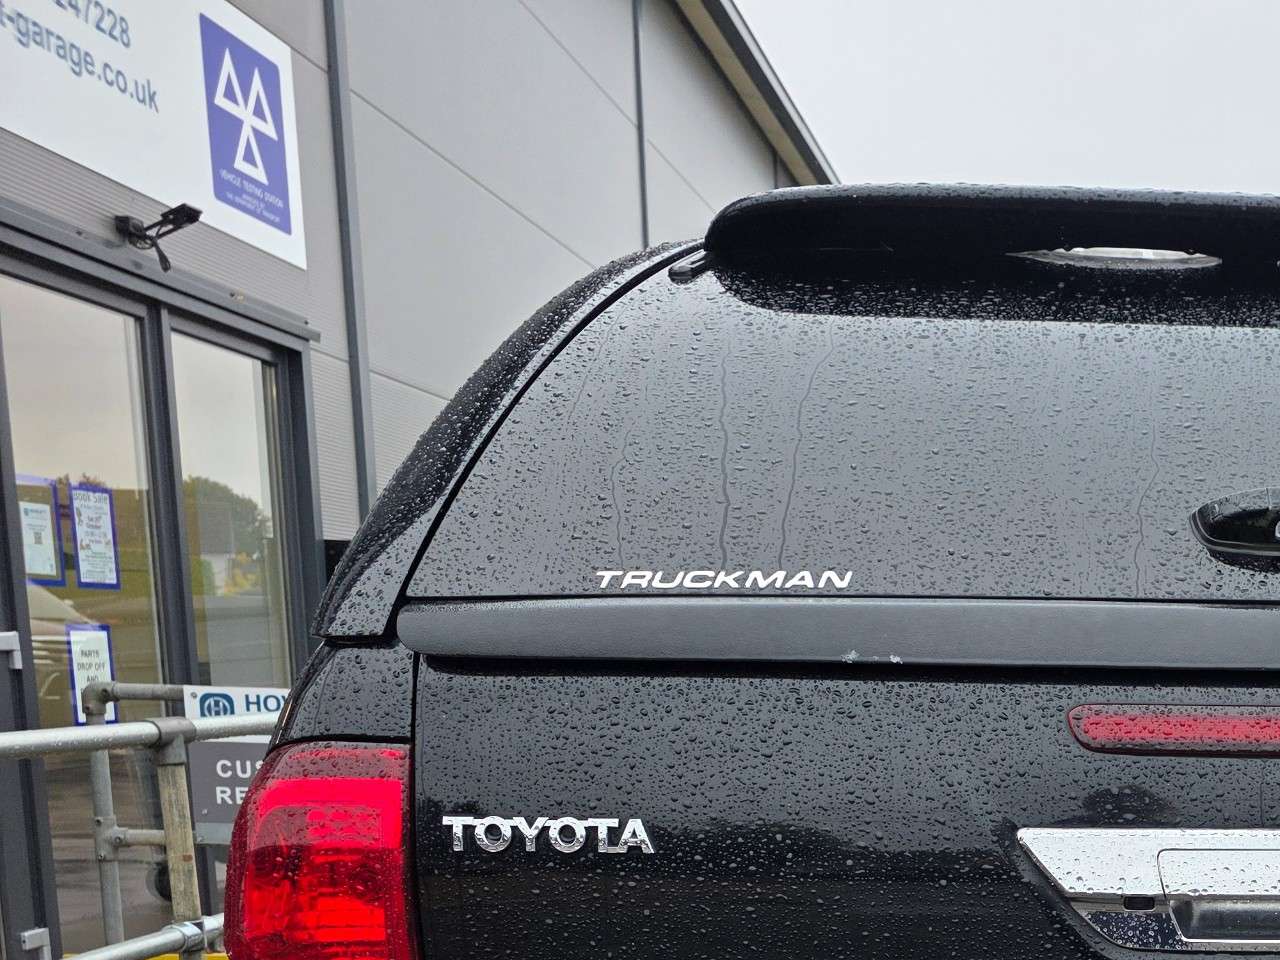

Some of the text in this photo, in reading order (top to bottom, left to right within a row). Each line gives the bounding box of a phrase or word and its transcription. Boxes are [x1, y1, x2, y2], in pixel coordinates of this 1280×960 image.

[54, 0, 131, 48] 47228
[595, 570, 853, 589] TRUCKMAN
[441, 815, 655, 854] TOYOTA
